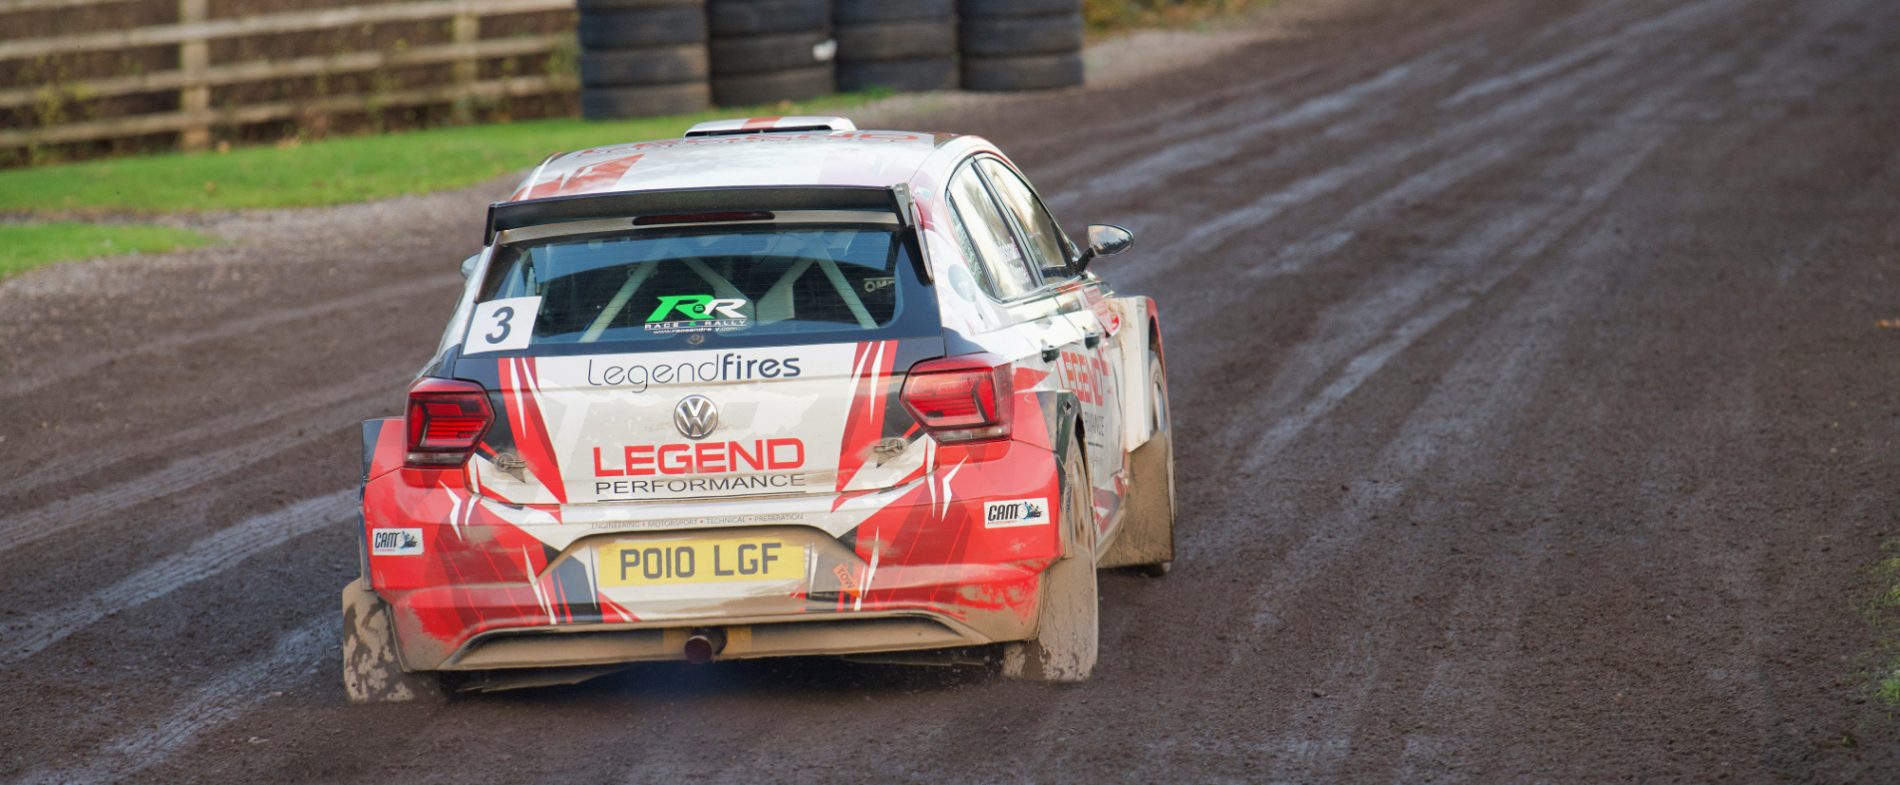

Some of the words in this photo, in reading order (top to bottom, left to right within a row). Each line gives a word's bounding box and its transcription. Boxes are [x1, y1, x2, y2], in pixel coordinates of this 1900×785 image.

[485, 306, 514, 345] 3
[588, 353, 801, 394] Legendfires
[1056, 351, 1104, 407] LEGEND
[593, 437, 805, 477] LEGEND
[595, 473, 807, 495] PERFORMANCE
[591, 520, 640, 529] ENGINEERING
[647, 518, 698, 528] MOTORSPORT
[704, 516, 746, 525] TECHNICAL
[620, 547, 695, 580] PO10
[713, 542, 782, 576] LGF
[837, 567, 855, 589] TOW
